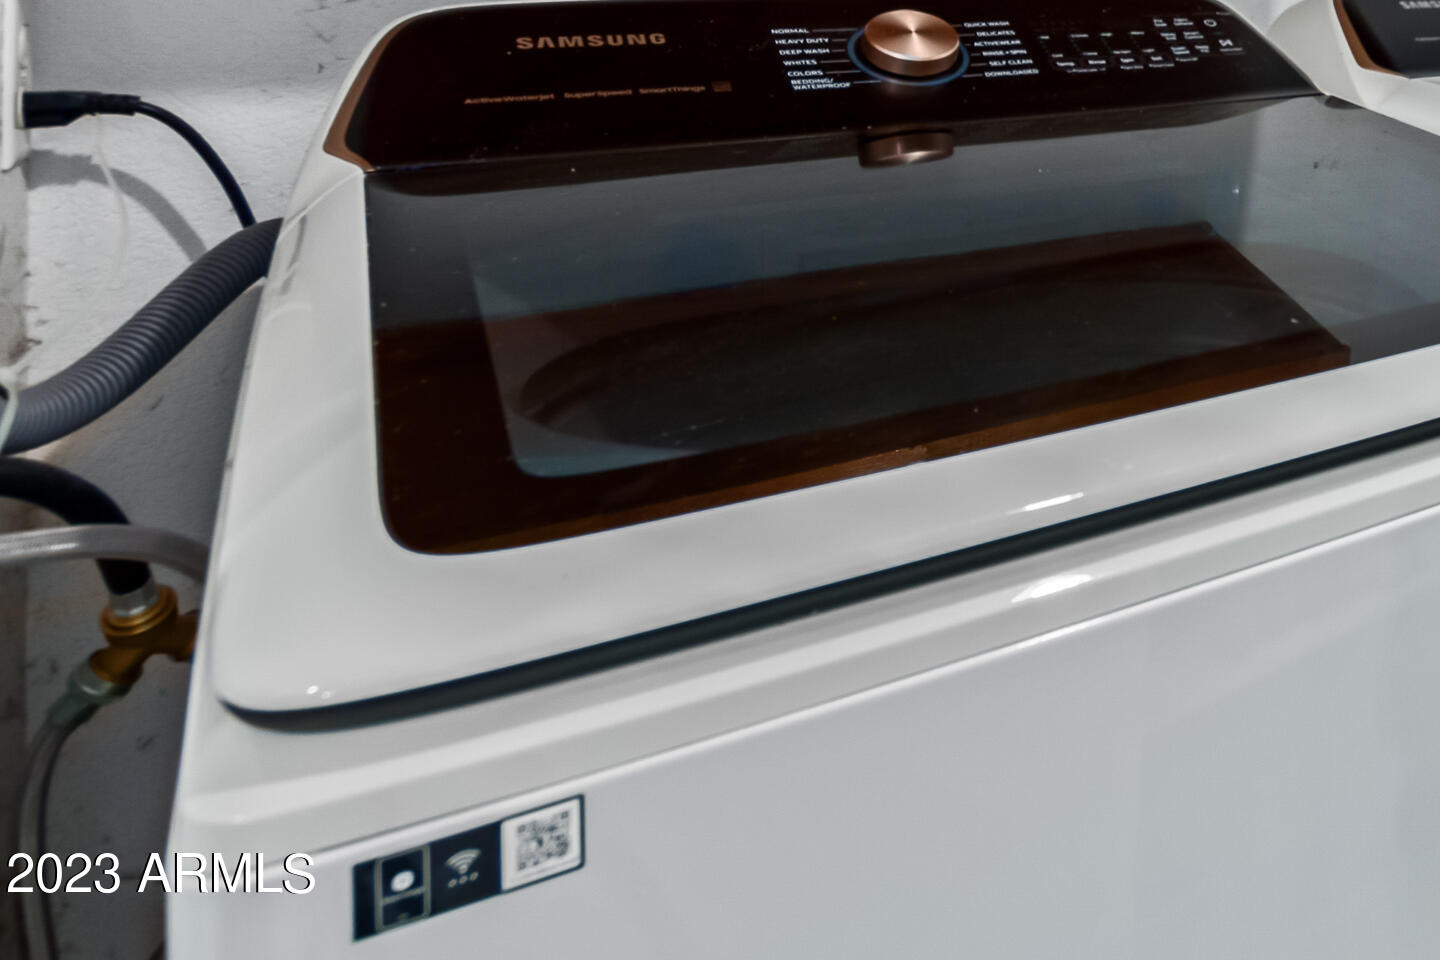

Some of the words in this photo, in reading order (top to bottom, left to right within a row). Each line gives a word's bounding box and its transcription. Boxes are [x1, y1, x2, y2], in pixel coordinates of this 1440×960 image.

[976, 30, 1016, 38] DELICATES
[515, 33, 667, 50] SAMSUNG
[984, 68, 1040, 77] DOWNLOADED
[792, 82, 851, 91] WATERPROOF
